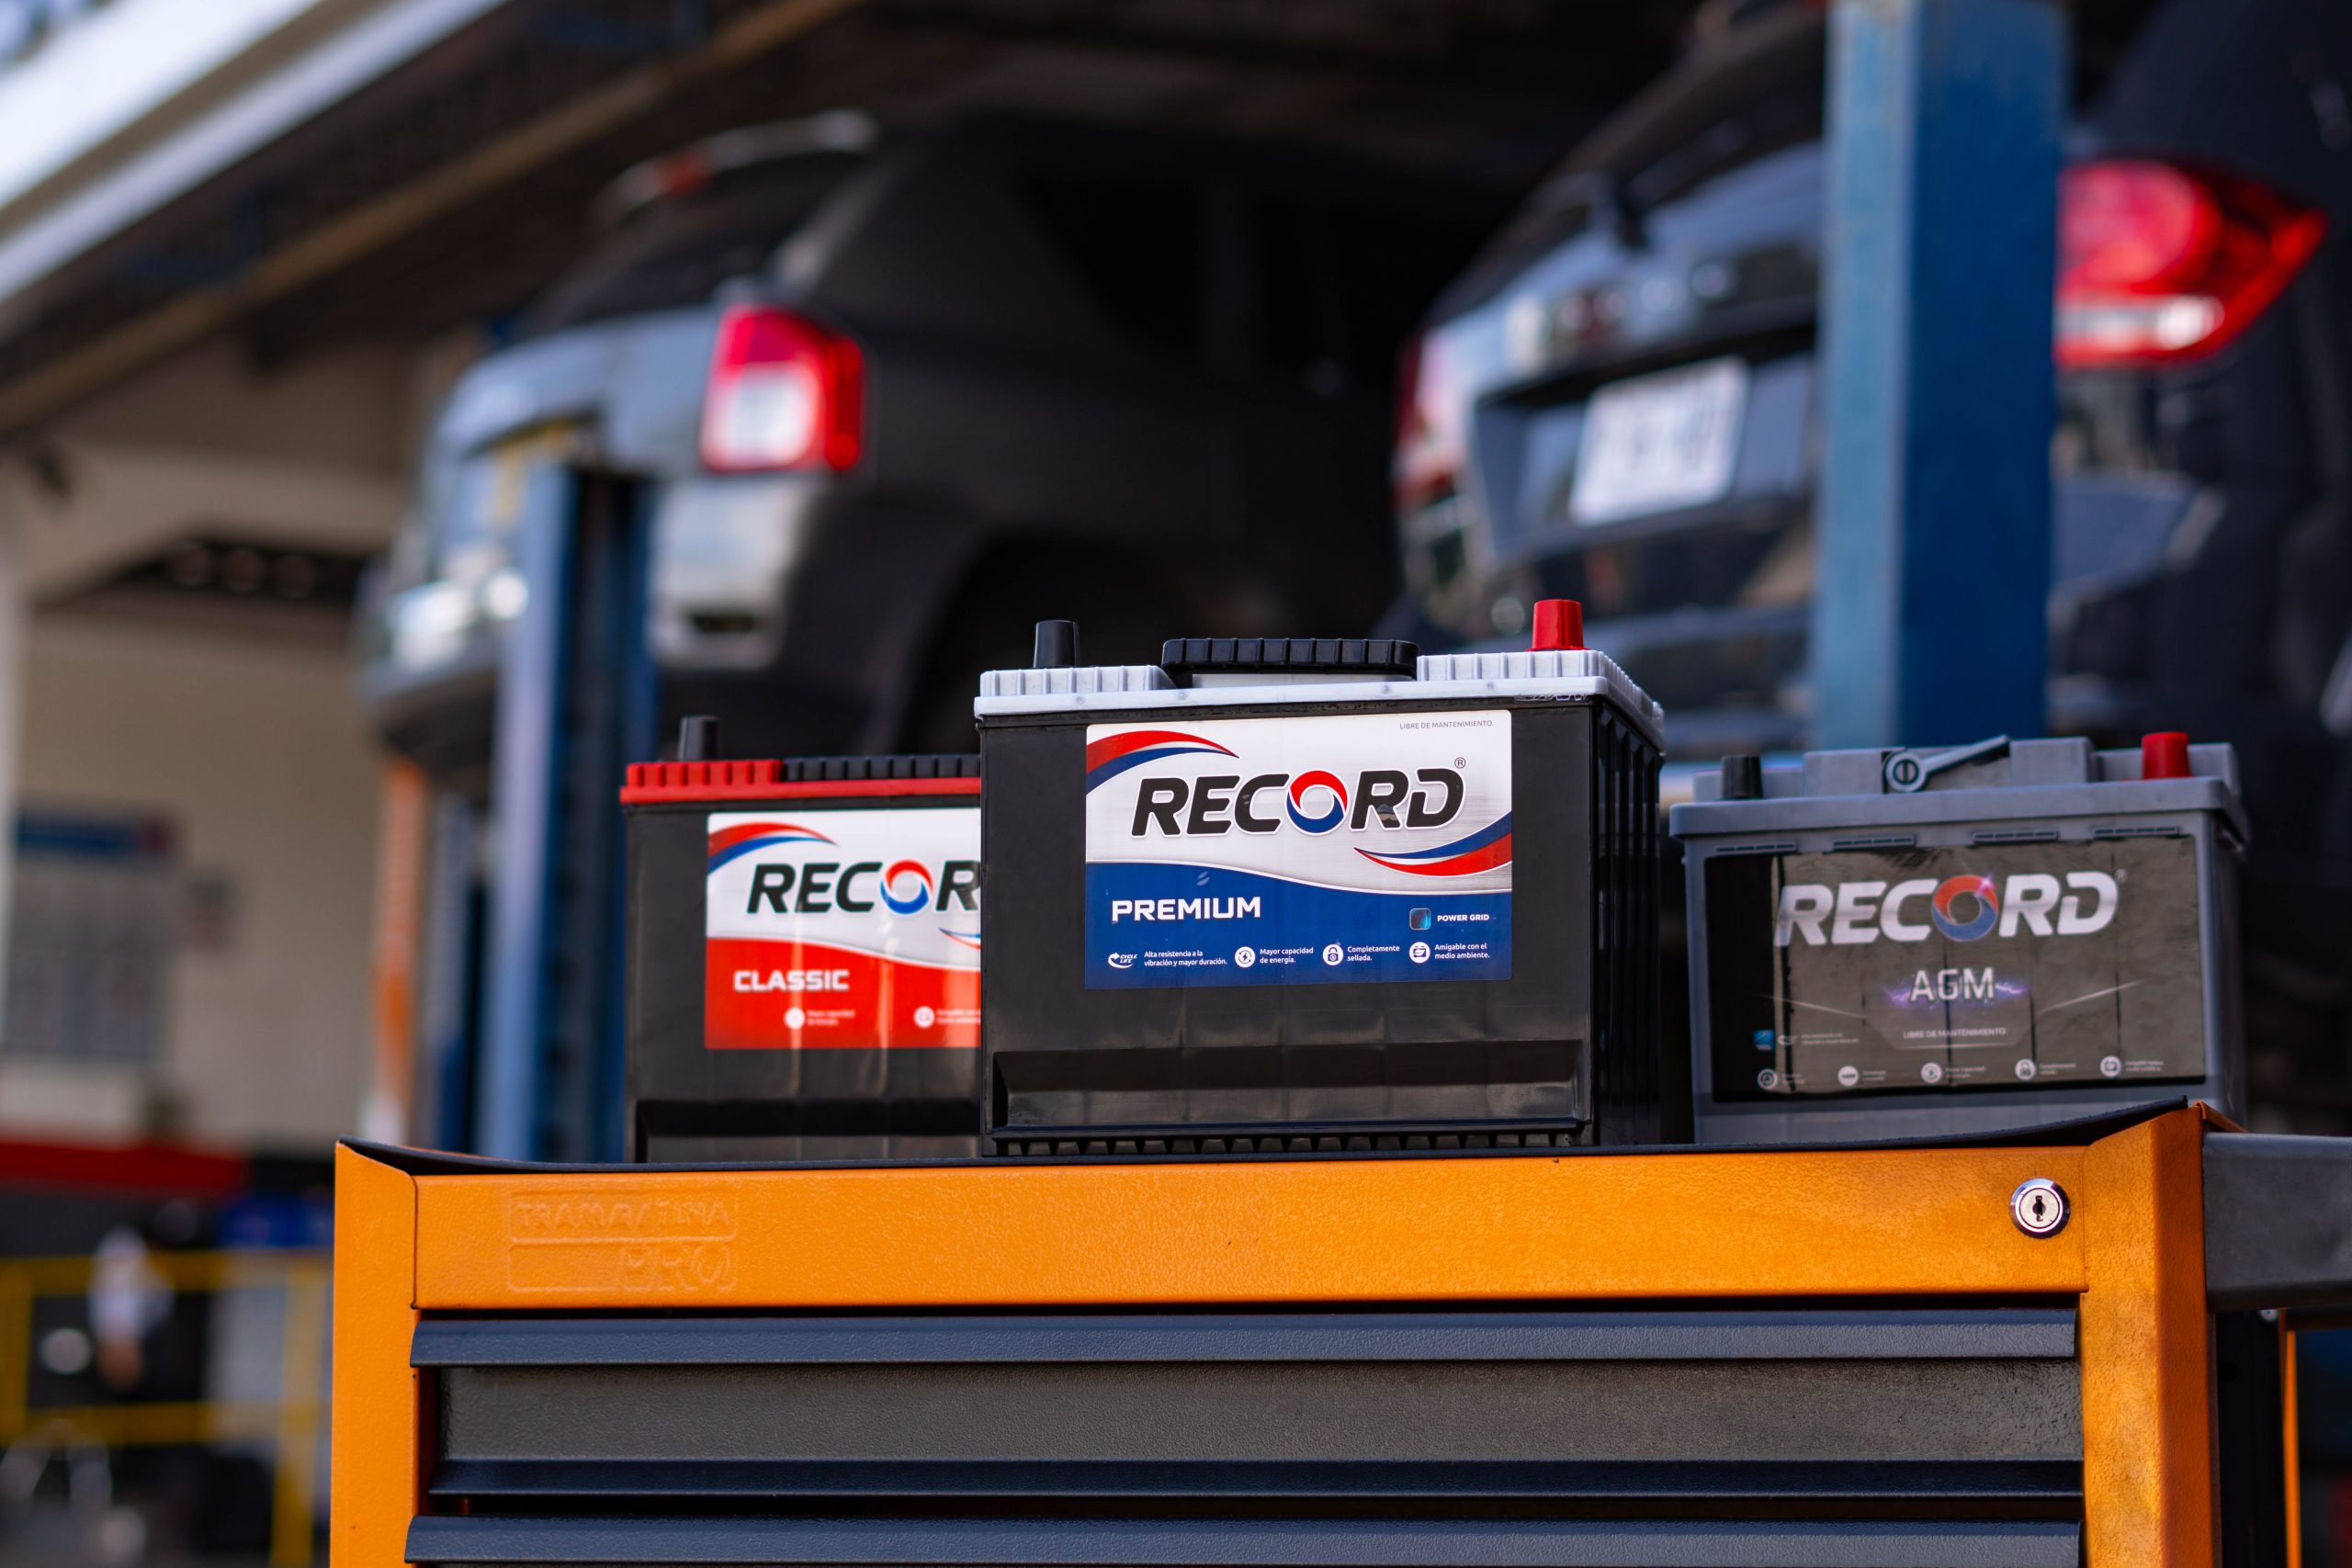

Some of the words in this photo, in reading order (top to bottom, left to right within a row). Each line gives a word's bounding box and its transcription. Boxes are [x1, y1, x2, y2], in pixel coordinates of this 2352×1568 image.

[1131, 768, 1464, 838] RECORD
[1111, 897, 1262, 922] PREMIUM
[1774, 870, 2119, 947] RECORD
[1437, 914, 1468, 922] POWER
[1260, 948, 1281, 956] Mayor
[1282, 946, 1314, 955] capacidad
[1347, 945, 1400, 954] Completamente
[1434, 943, 1466, 953] Amigable
[1197, 950, 1204, 958] la
[1456, 952, 1490, 960] ambiente.
[1144, 959, 1173, 967] vibración
[1198, 957, 1227, 965] duración.
[734, 970, 850, 992] CLASSIC
[1910, 968, 1995, 1000] AGM
[1903, 1031, 1924, 1039] LIBRE
